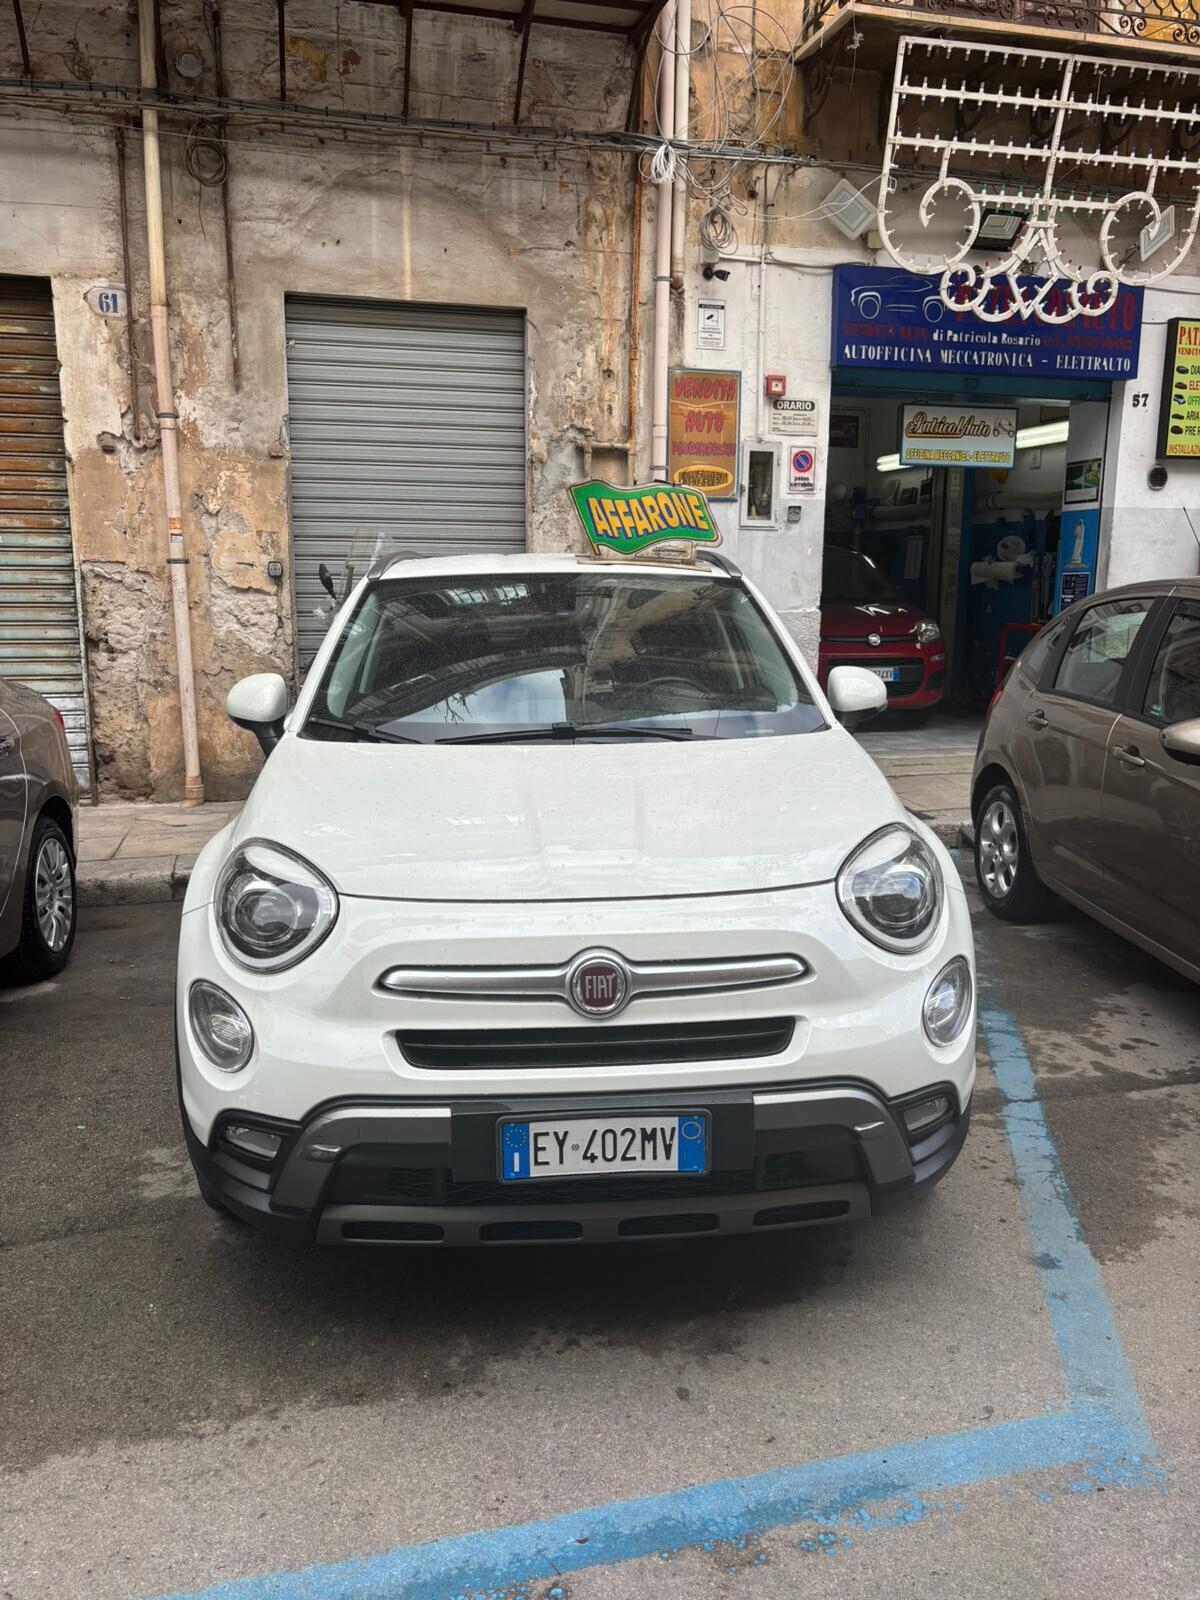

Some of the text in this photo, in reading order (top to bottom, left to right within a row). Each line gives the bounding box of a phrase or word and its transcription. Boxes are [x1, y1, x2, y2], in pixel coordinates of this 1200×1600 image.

[99, 292, 119, 313] 61
[932, 329, 943, 341] di
[947, 330, 998, 345] Patricola
[1001, 333, 1040, 346] Rosario
[1178, 326, 1200, 346] PAT
[844, 345, 931, 362] AUTOFFICINA
[940, 350, 1034, 368] MECCATRONICA
[1056, 355, 1131, 371] ELETTRAUTO
[674, 376, 736, 402] VENDITA
[1132, 393, 1149, 408] 57
[777, 401, 812, 410] ORARIO
[685, 410, 725, 433] AUTO
[586, 491, 708, 539] AFFARONE
[585, 974, 616, 999] FIAT
[533, 1131, 569, 1166] EY
[582, 1127, 676, 1164] 402MV
